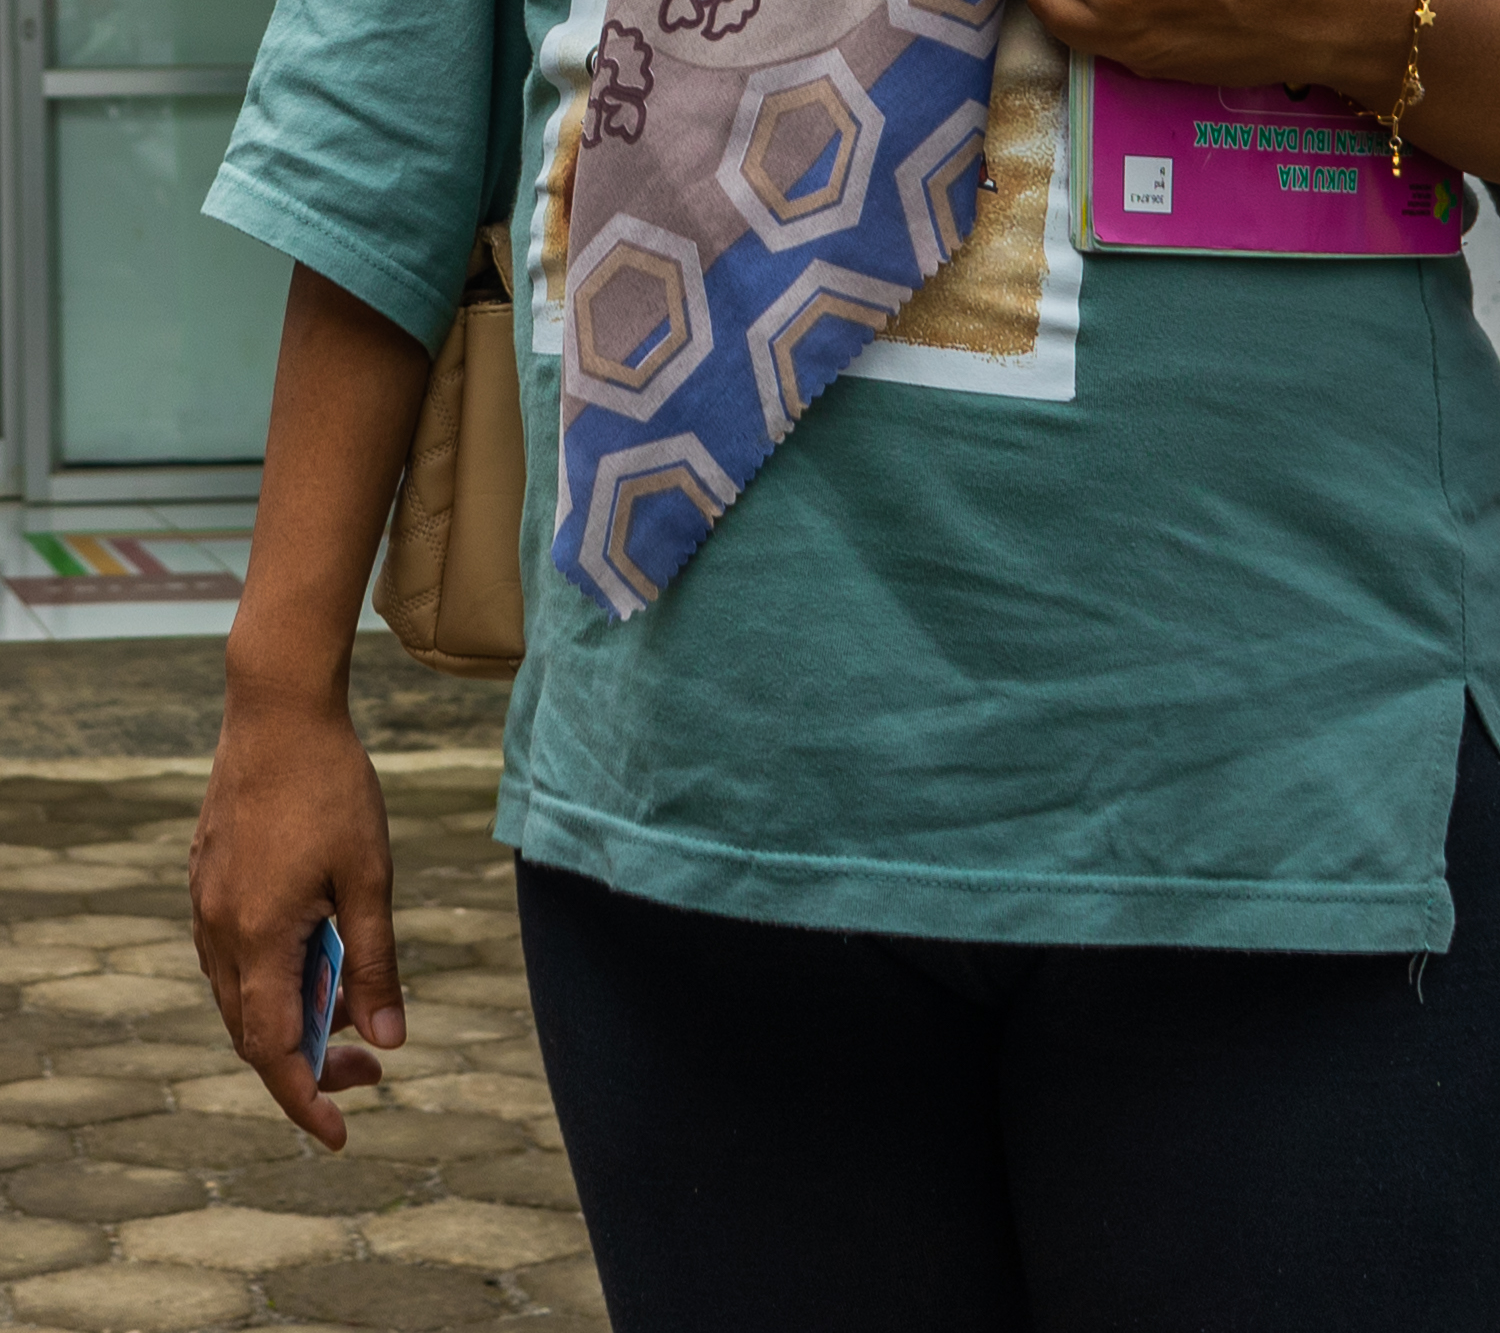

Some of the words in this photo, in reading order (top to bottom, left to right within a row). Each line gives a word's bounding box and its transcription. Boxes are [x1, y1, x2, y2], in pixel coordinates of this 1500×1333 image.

[1193, 121, 1253, 148] ANAK
[1258, 126, 1298, 150] DAN
[1303, 128, 1332, 152] IBU
[1277, 165, 1310, 191] KIA
[1313, 166, 1358, 193] BUKU
